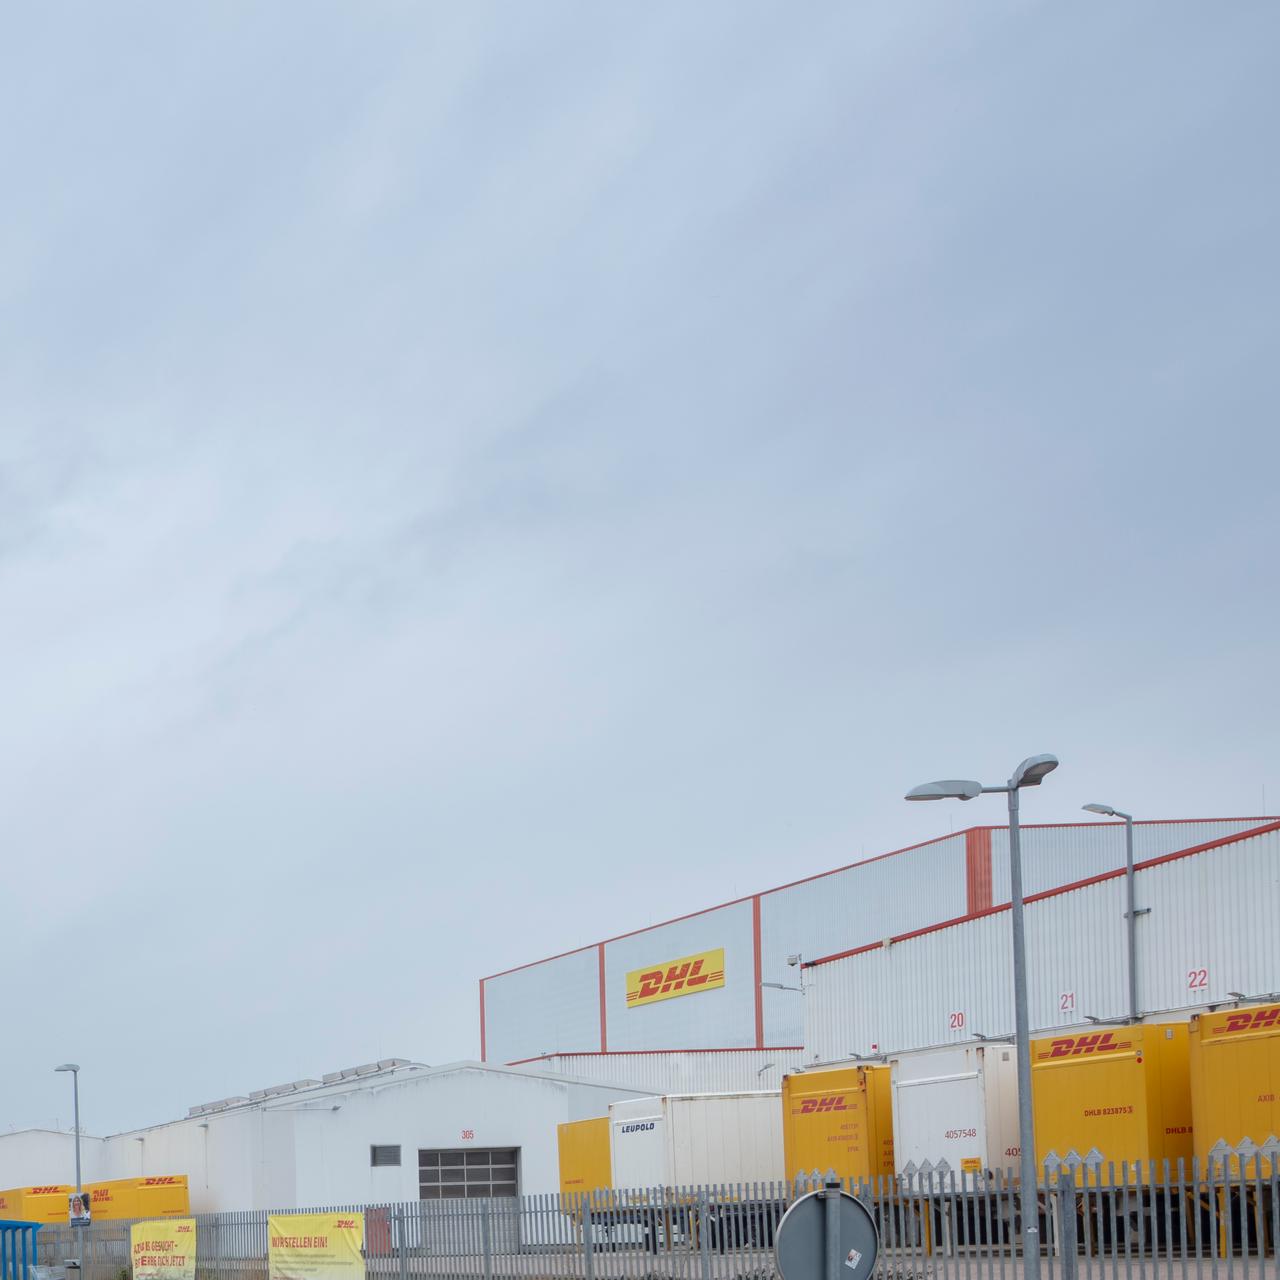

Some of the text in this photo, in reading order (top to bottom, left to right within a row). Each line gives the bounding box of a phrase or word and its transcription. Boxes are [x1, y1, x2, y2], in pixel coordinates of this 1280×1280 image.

[638, 959, 708, 998] DHL
[1188, 969, 1207, 988] 22
[1061, 993, 1075, 1010] 21
[949, 1012, 964, 1028] 20
[1050, 1033, 1118, 1057] DHL
[801, 1096, 847, 1114] DHL
[1084, 1109, 1101, 1117] DHLB
[621, 1123, 655, 1133] LEUPOLD
[944, 1128, 977, 1140] 4057548
[461, 1130, 474, 1140] 305
[145, 1177, 175, 1185] DHL
[32, 1186, 60, 1194] DHL
[271, 1236, 328, 1248] WIR STELLEN EIN!
